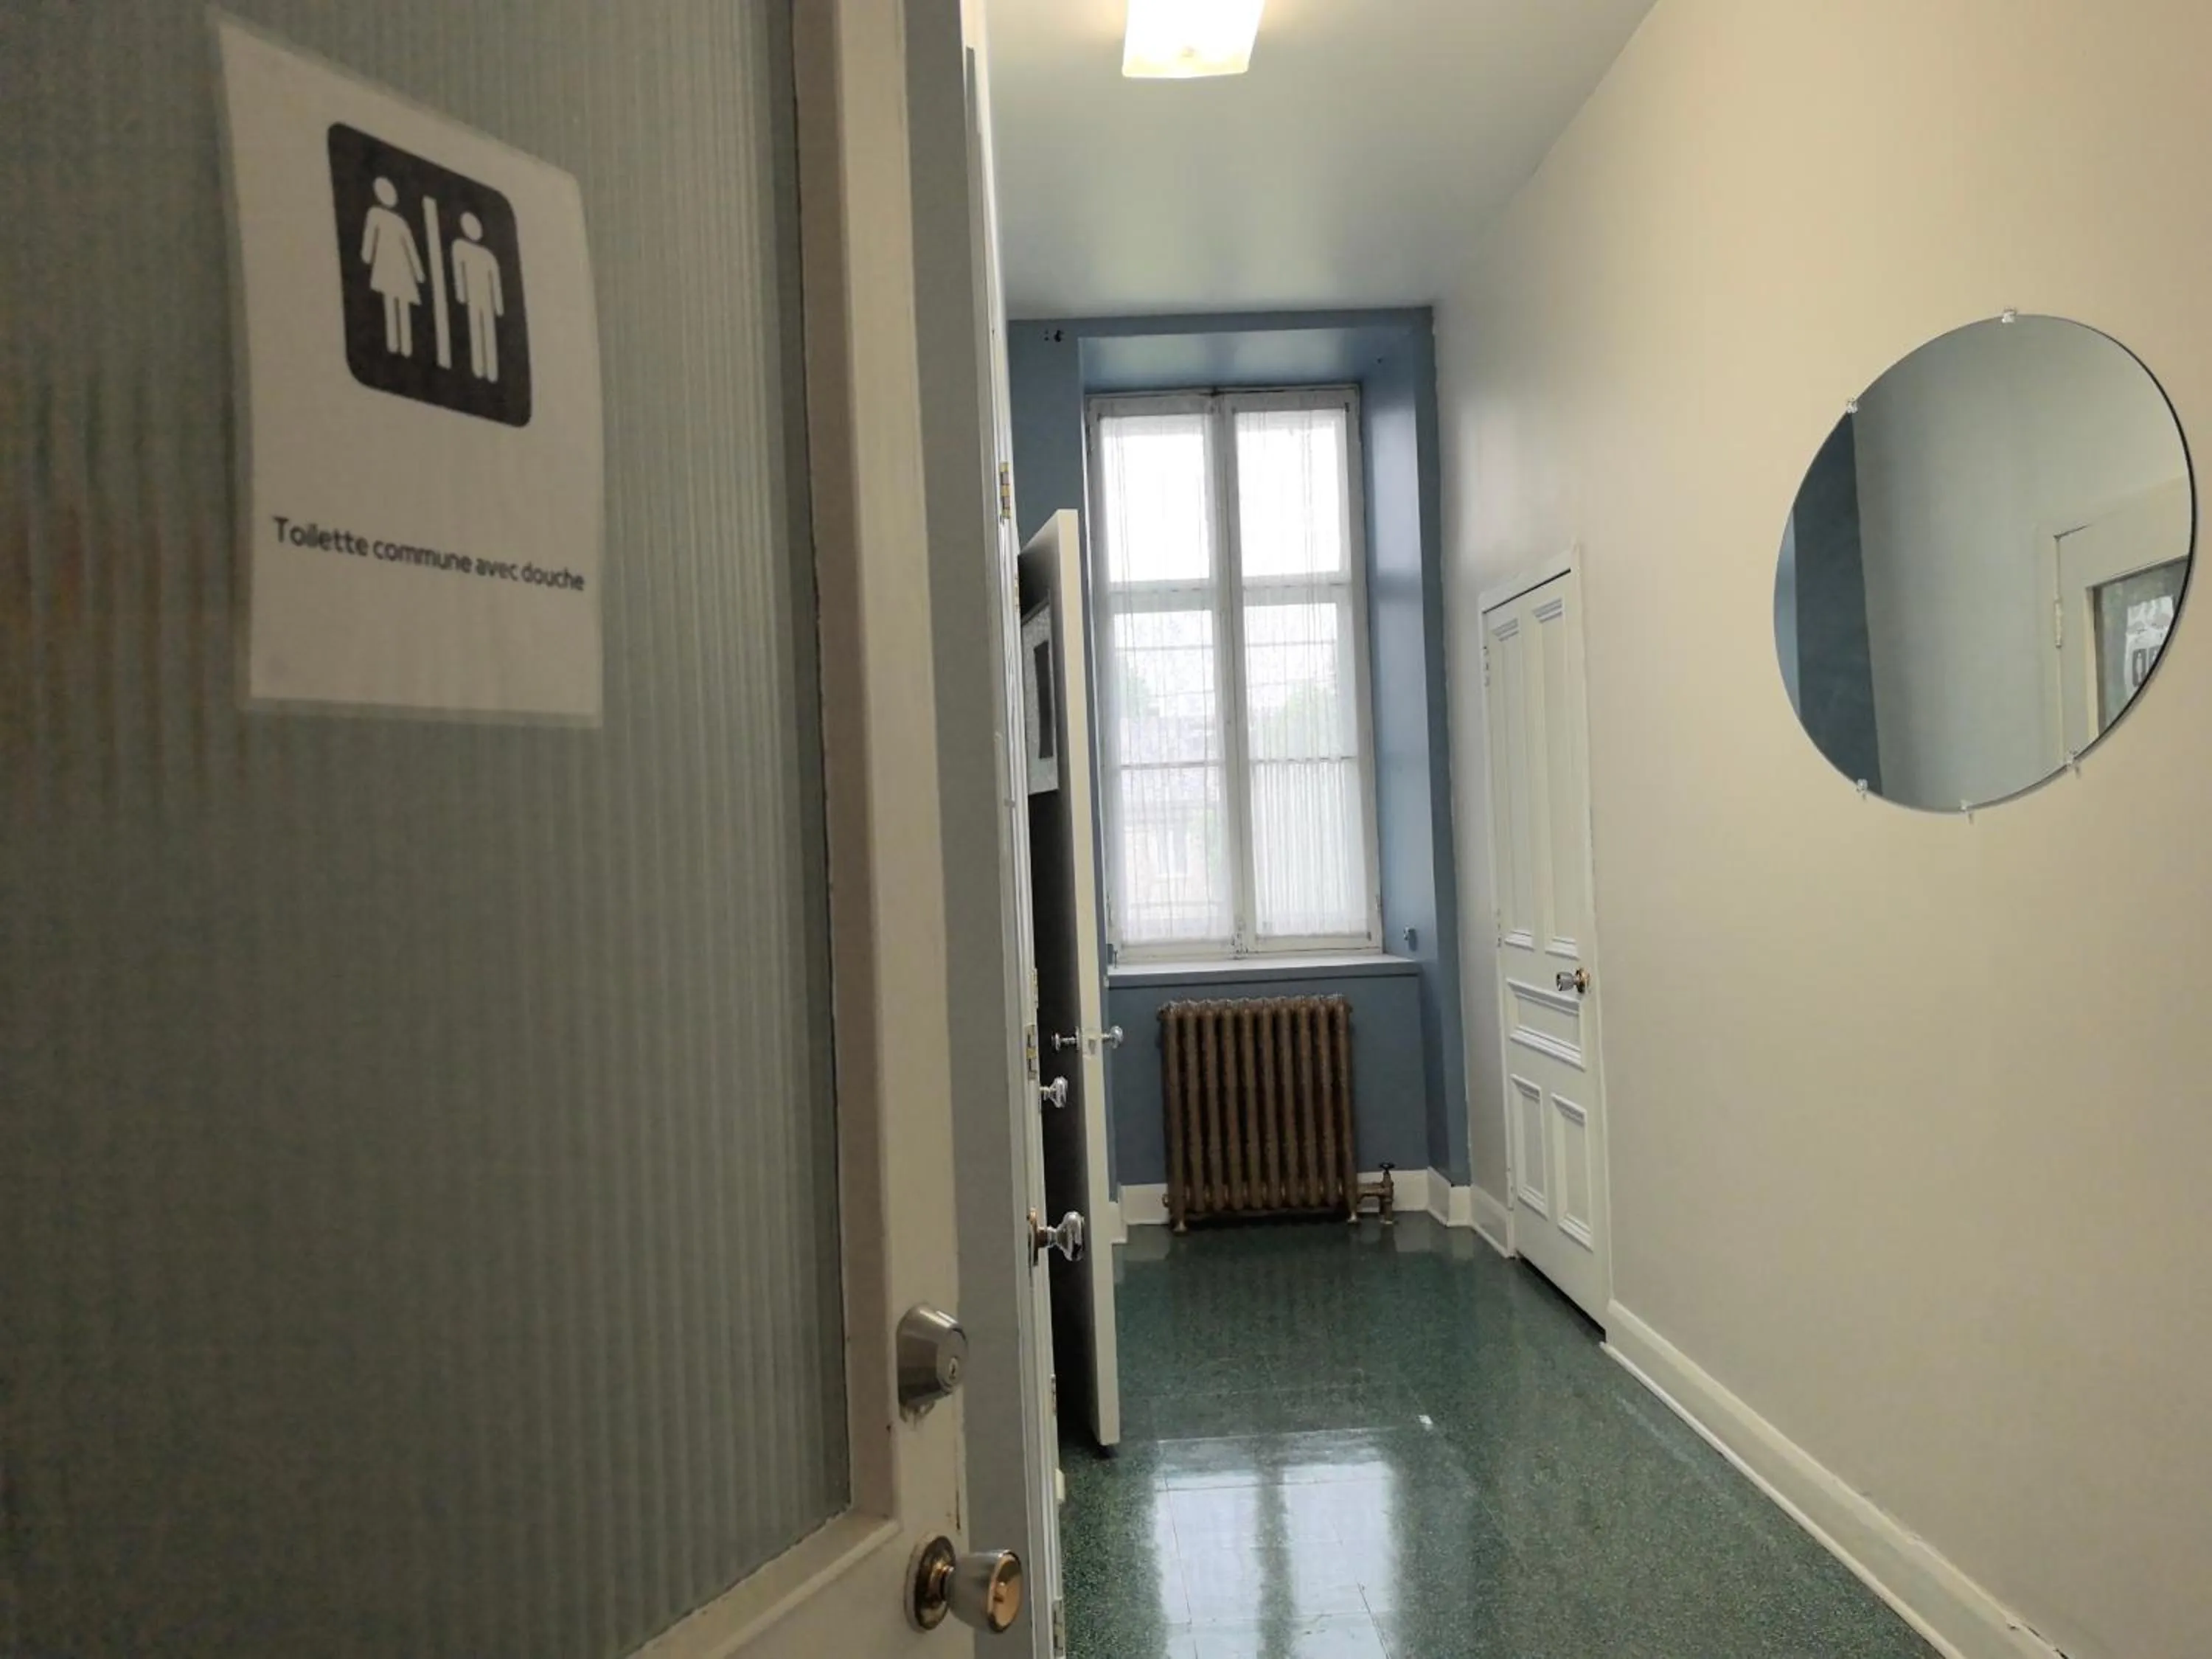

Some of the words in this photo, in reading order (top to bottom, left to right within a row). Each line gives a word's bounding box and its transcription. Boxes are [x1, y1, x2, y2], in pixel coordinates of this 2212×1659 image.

[274, 516, 369, 557] Toilette
[372, 539, 473, 573] commune
[476, 558, 518, 581] avec
[522, 563, 585, 591] douche
